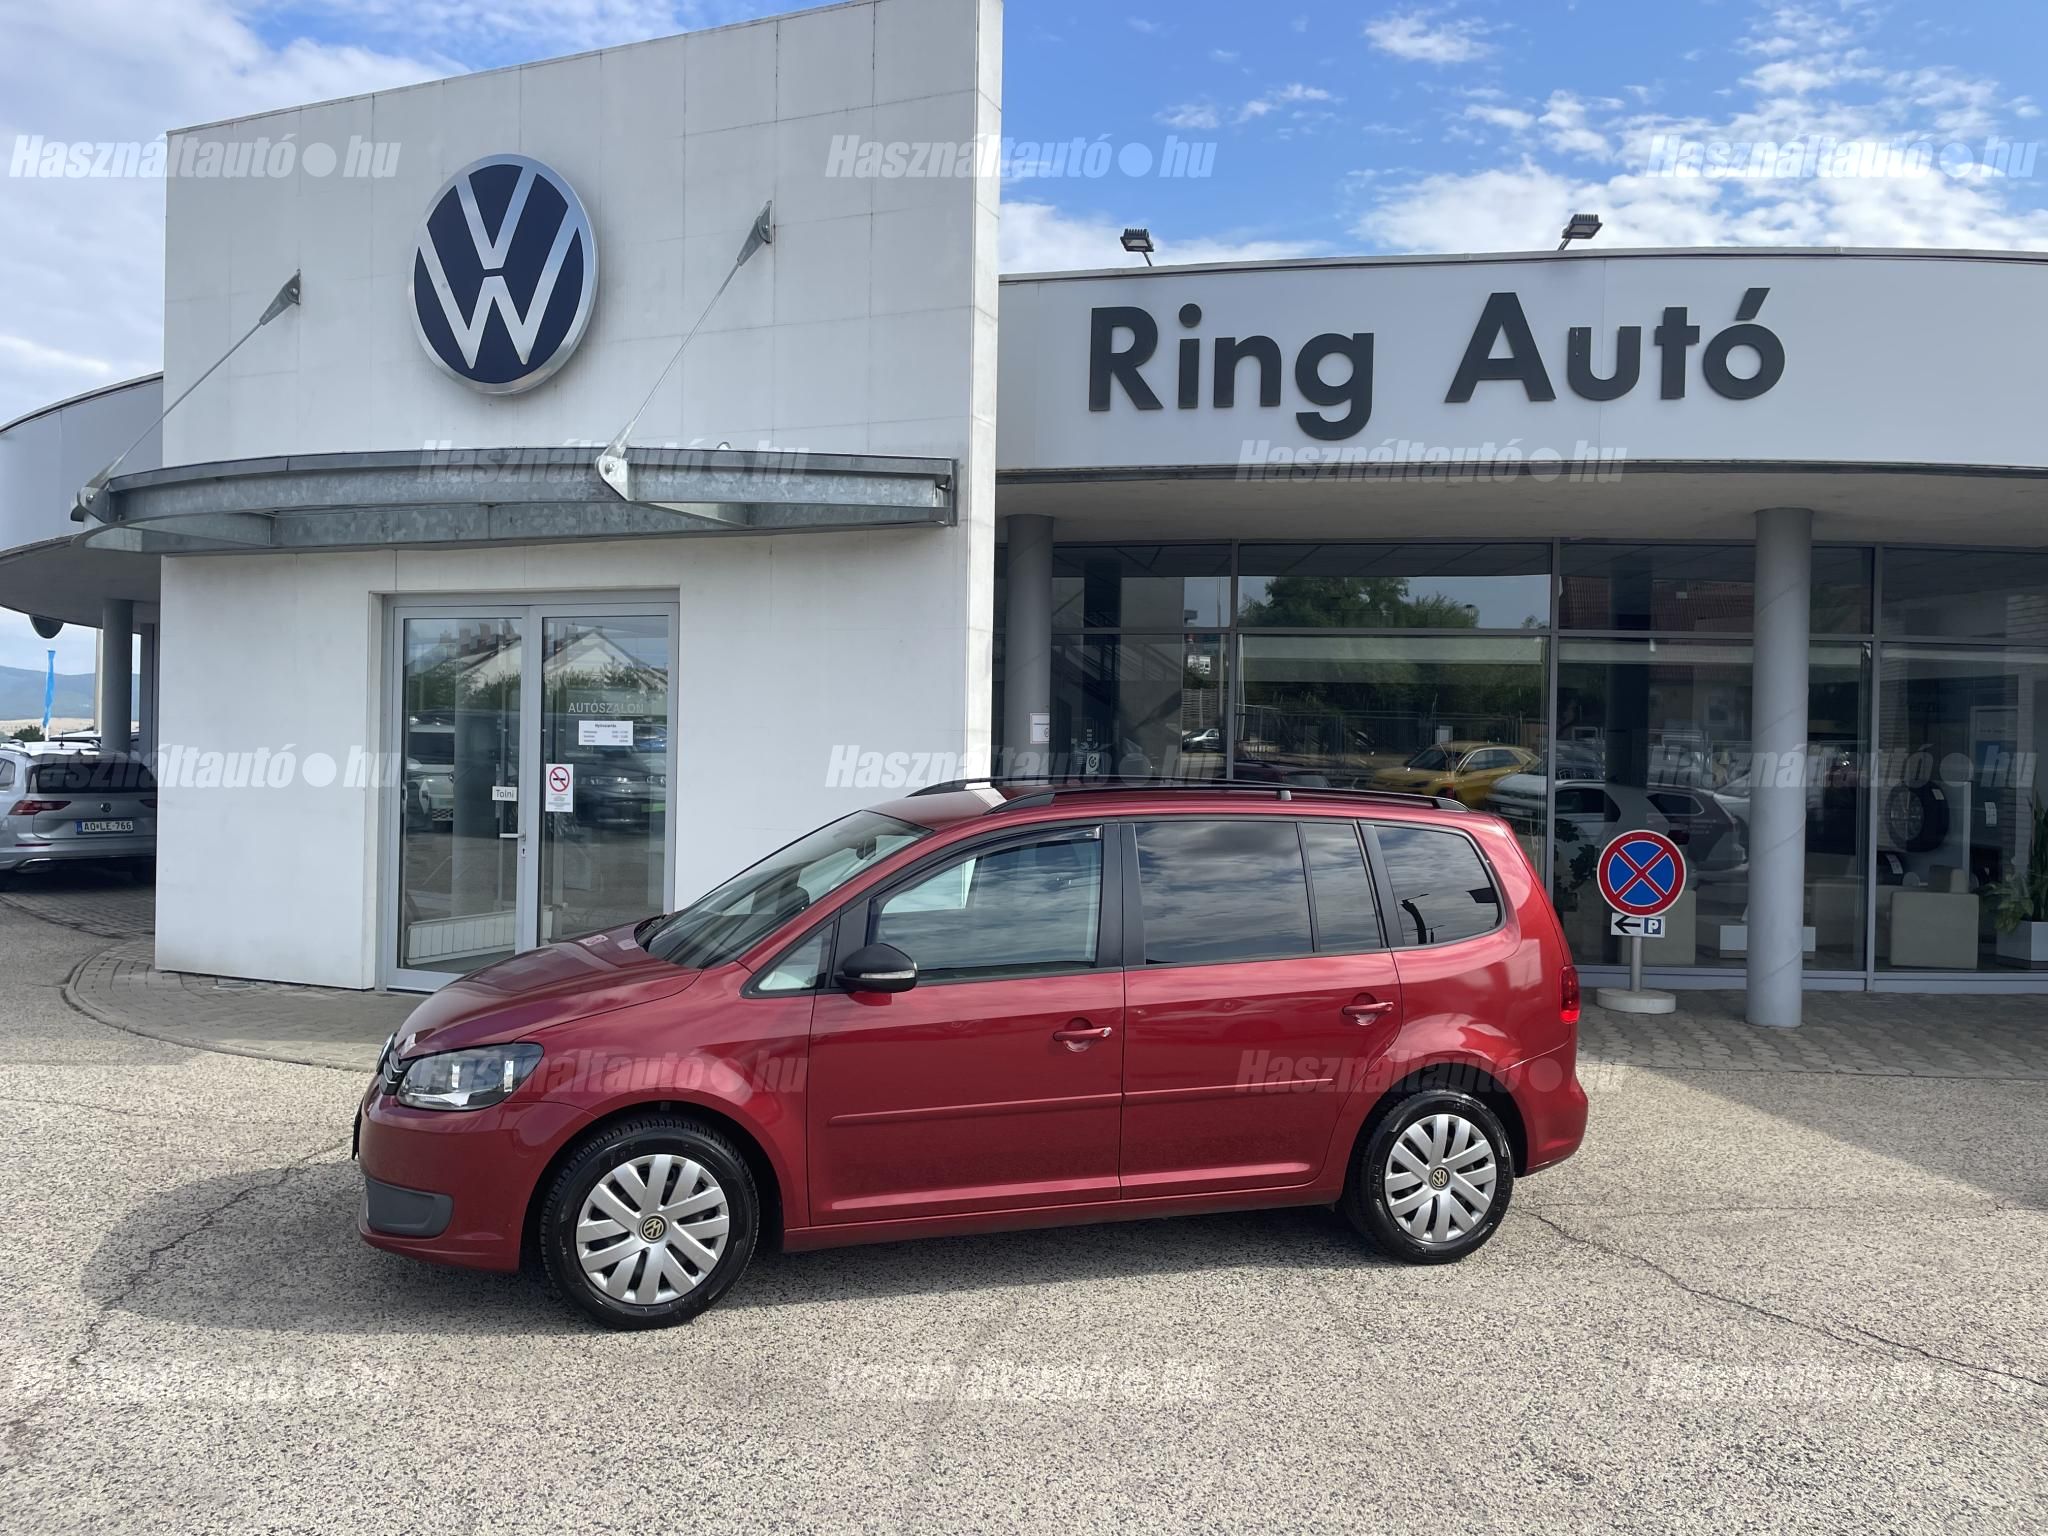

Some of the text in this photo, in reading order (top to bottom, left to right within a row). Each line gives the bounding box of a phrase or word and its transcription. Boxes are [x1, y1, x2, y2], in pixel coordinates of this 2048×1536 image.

[1088, 287, 1786, 441] Ring Autó
[495, 789, 514, 798] Tolni
[1647, 919, 1659, 933] P
